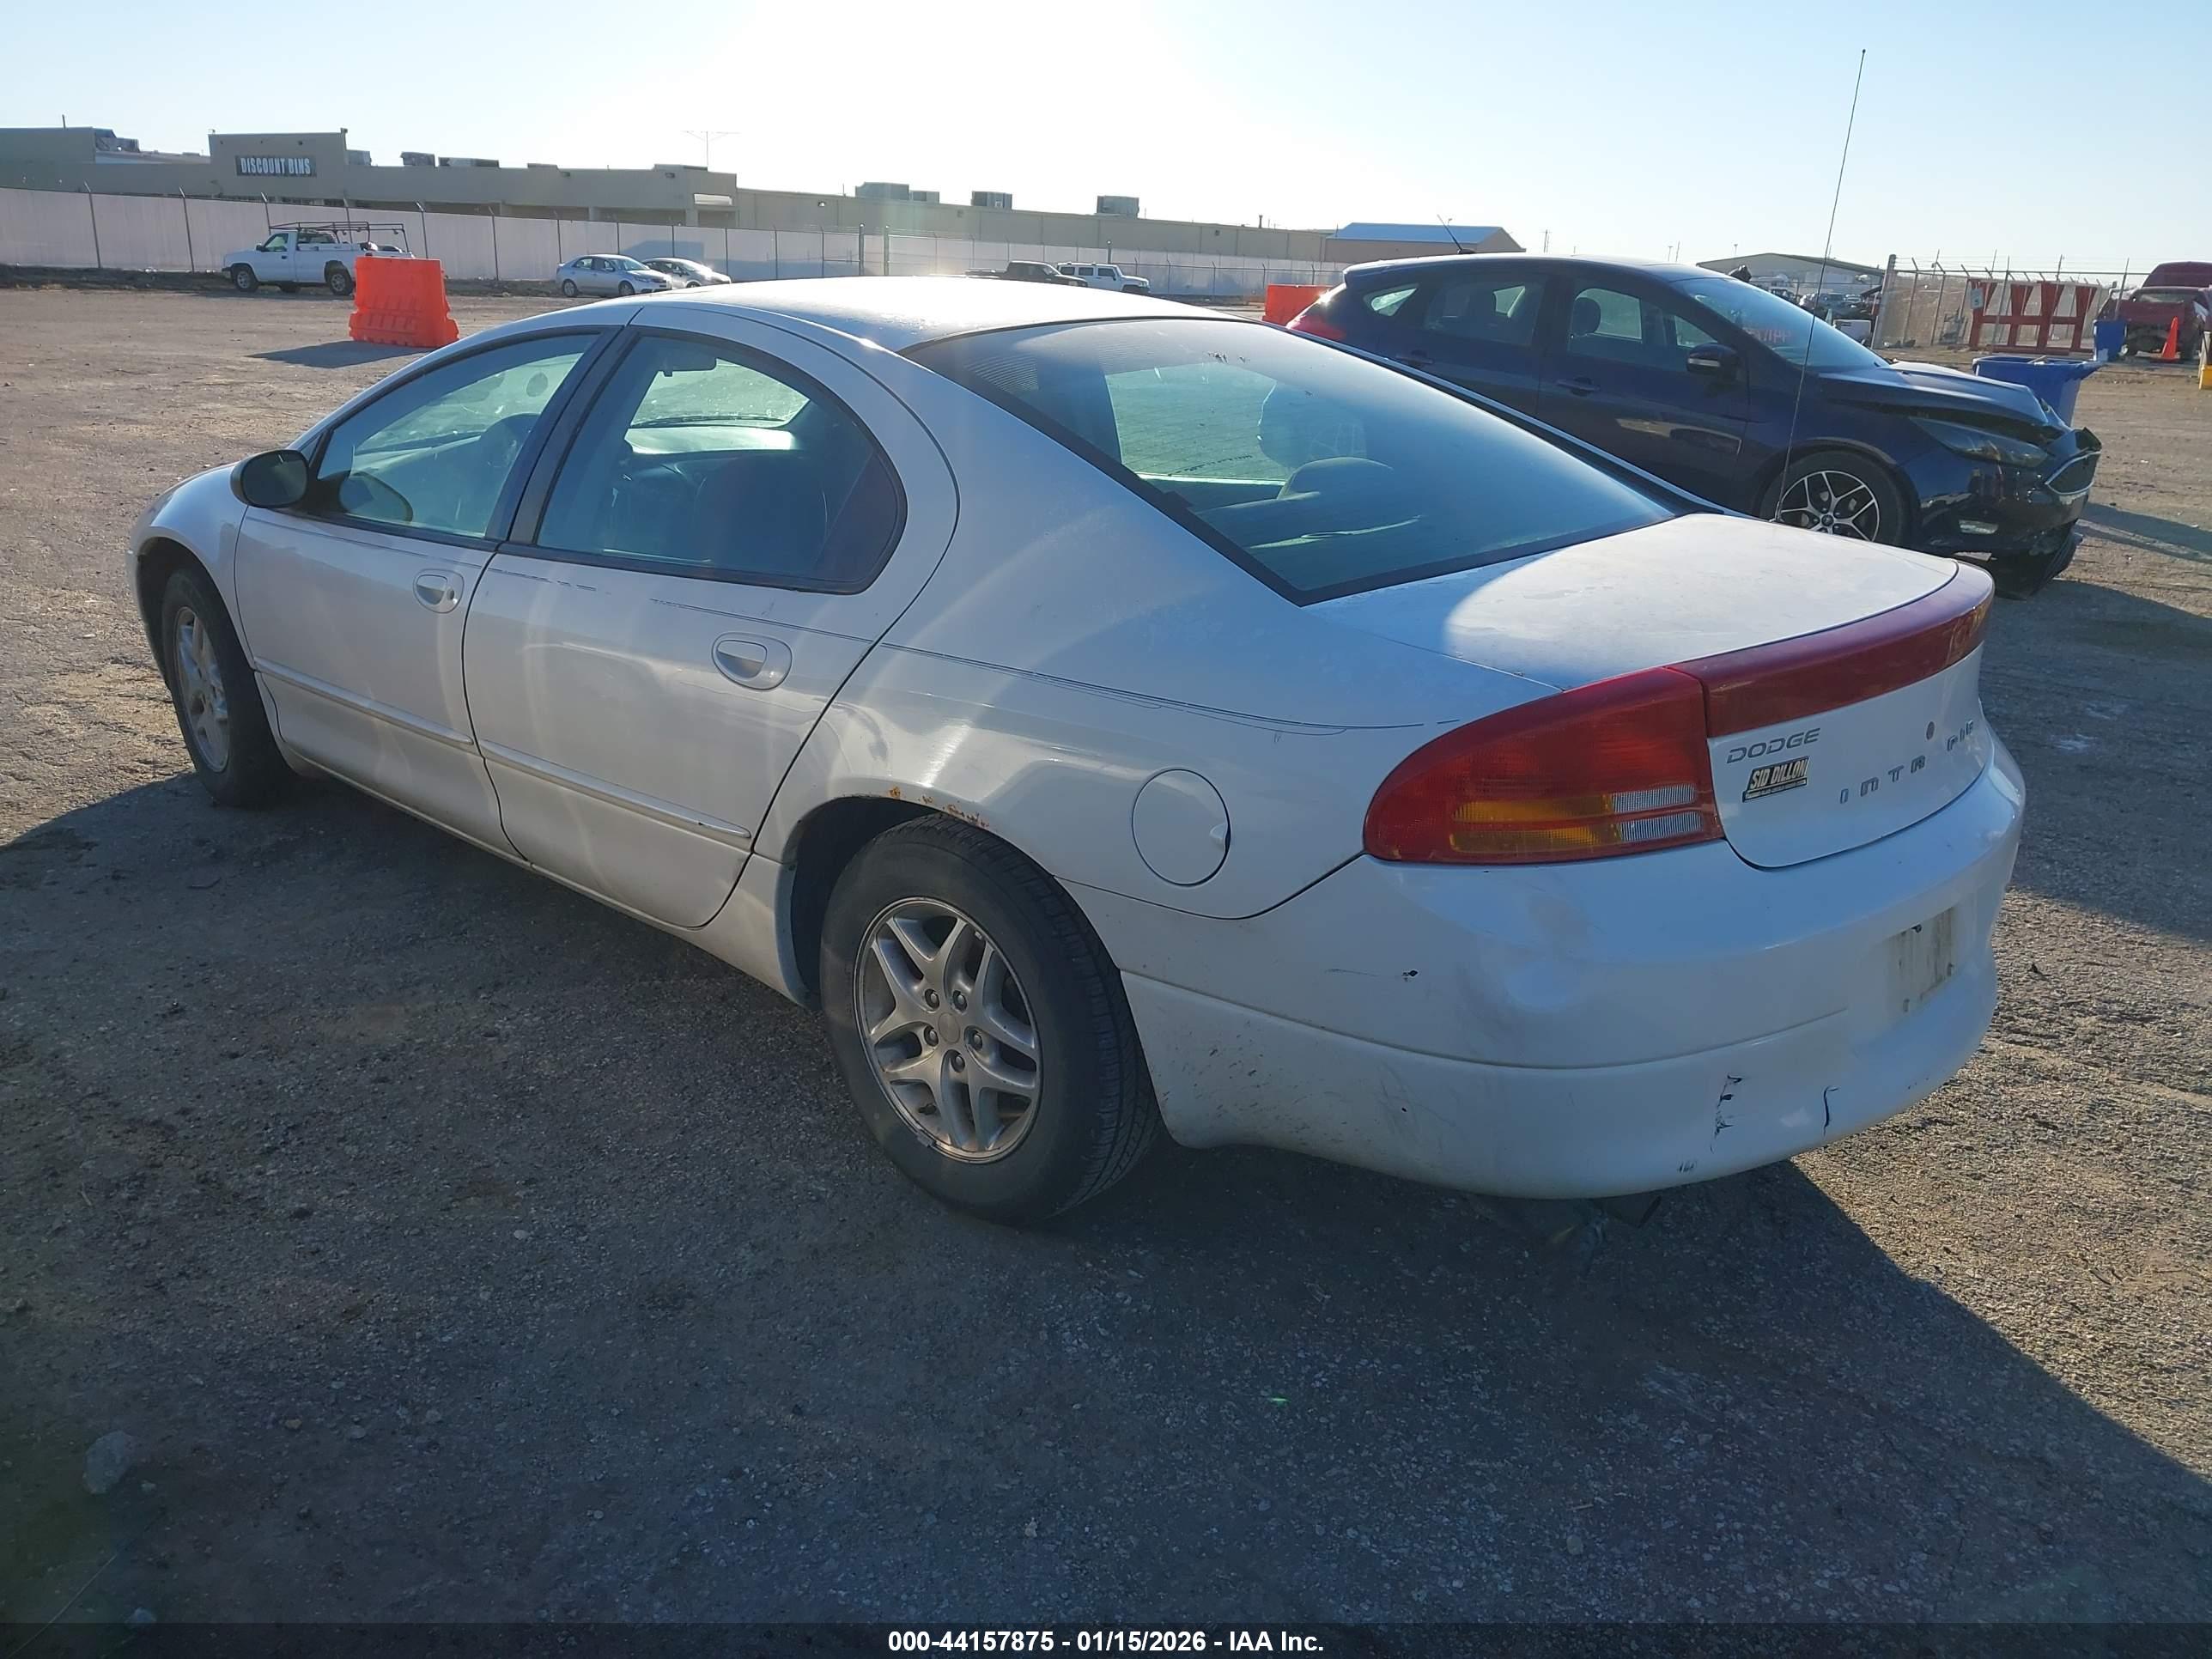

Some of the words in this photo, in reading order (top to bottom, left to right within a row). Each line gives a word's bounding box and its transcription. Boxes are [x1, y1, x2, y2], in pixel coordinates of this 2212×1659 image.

[240, 157, 285, 174] DISCOUNT
[288, 157, 311, 175] BINS
[1726, 727, 1821, 764] DODGE
[1750, 768, 1771, 789] SID
[1771, 759, 1808, 785] DILLON
